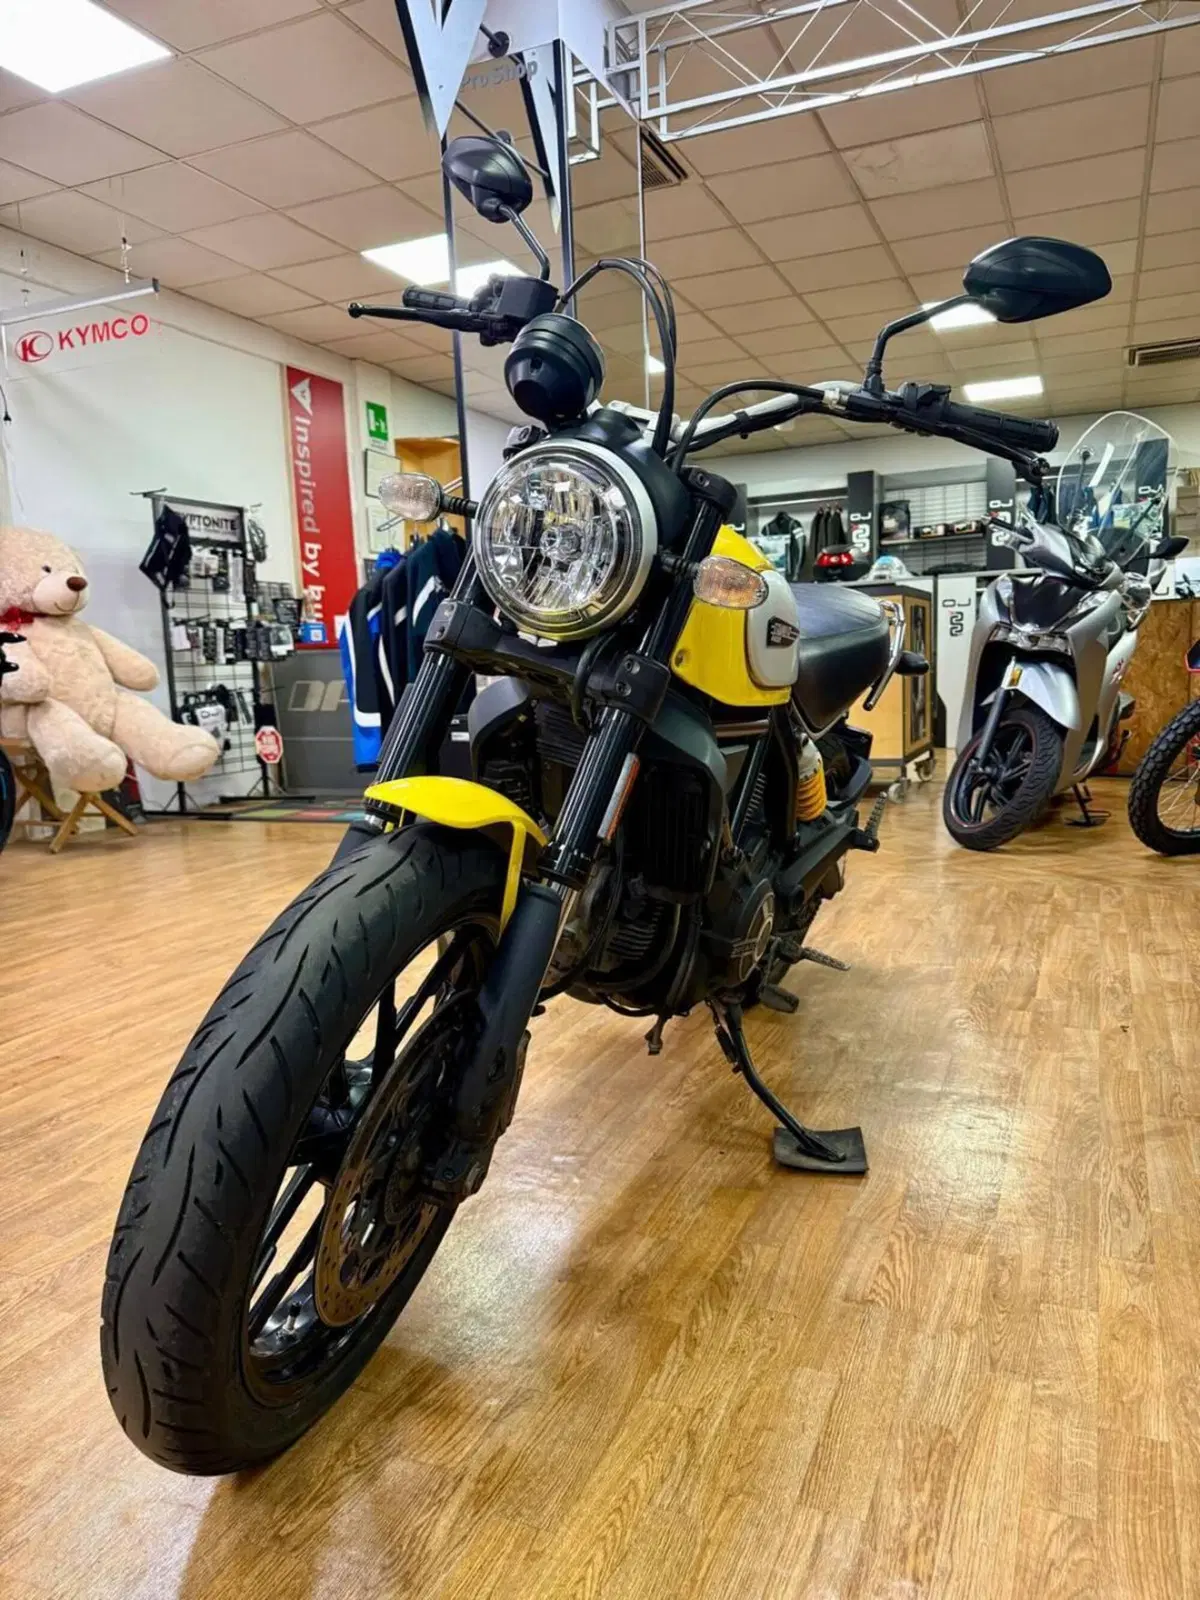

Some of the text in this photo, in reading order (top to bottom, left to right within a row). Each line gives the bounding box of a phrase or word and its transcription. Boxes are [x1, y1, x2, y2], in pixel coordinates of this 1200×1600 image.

[58, 314, 149, 350] KYMCO
[294, 415, 320, 534] Inspired
[302, 542, 323, 578] by
